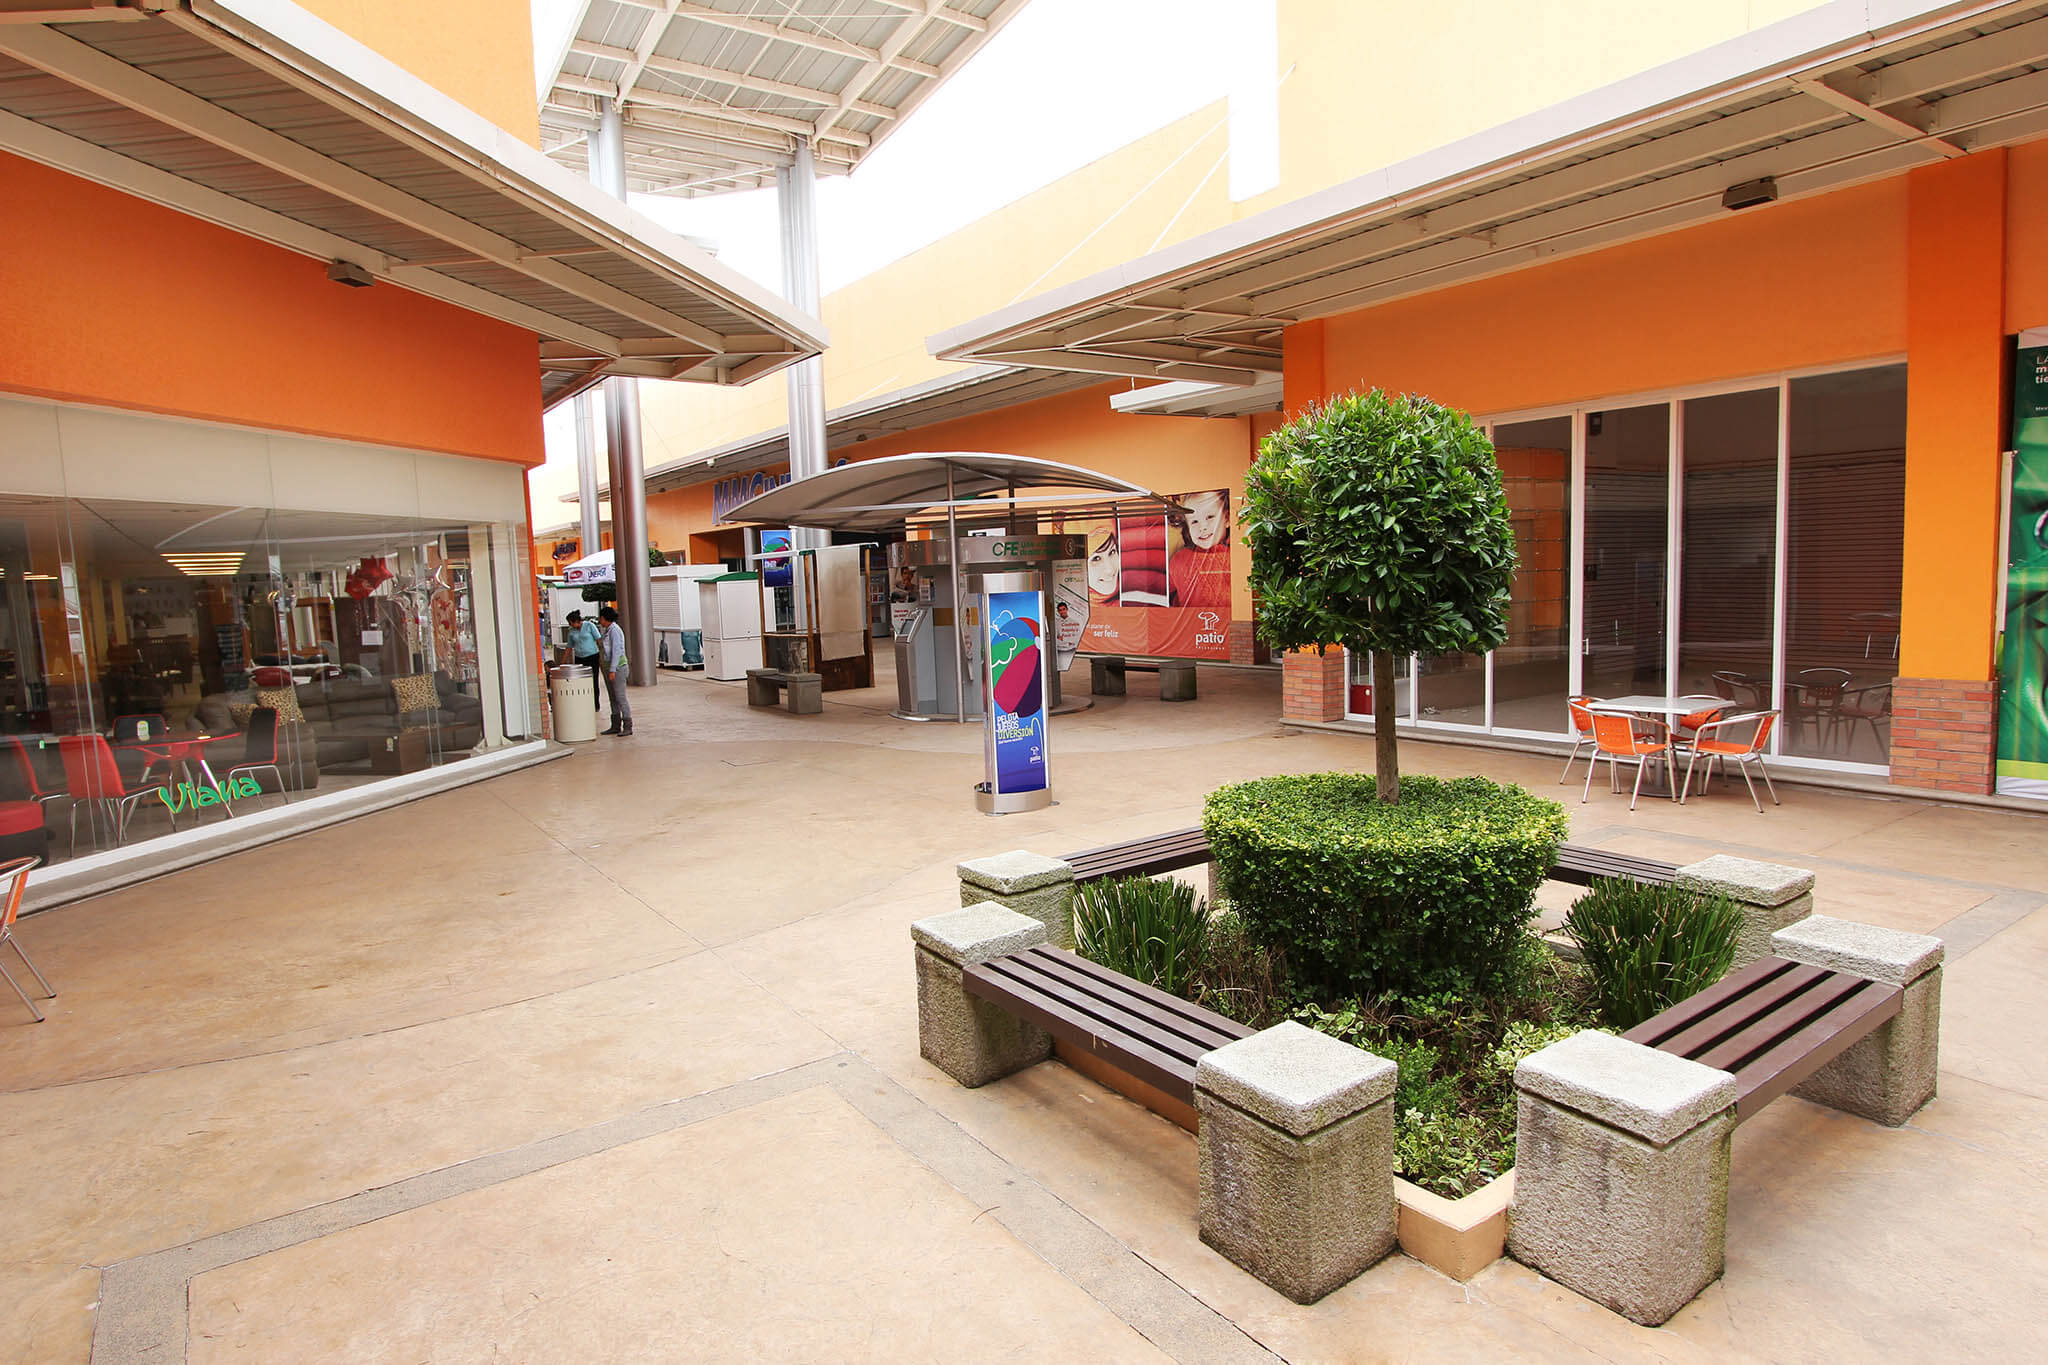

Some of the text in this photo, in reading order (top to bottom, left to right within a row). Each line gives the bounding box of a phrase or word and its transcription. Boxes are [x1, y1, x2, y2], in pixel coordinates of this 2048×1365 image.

[992, 541, 1019, 557] CFE
[1195, 631, 1225, 646] patio
[997, 711, 1019, 722] PELOTA
[157, 777, 262, 814] Viana
